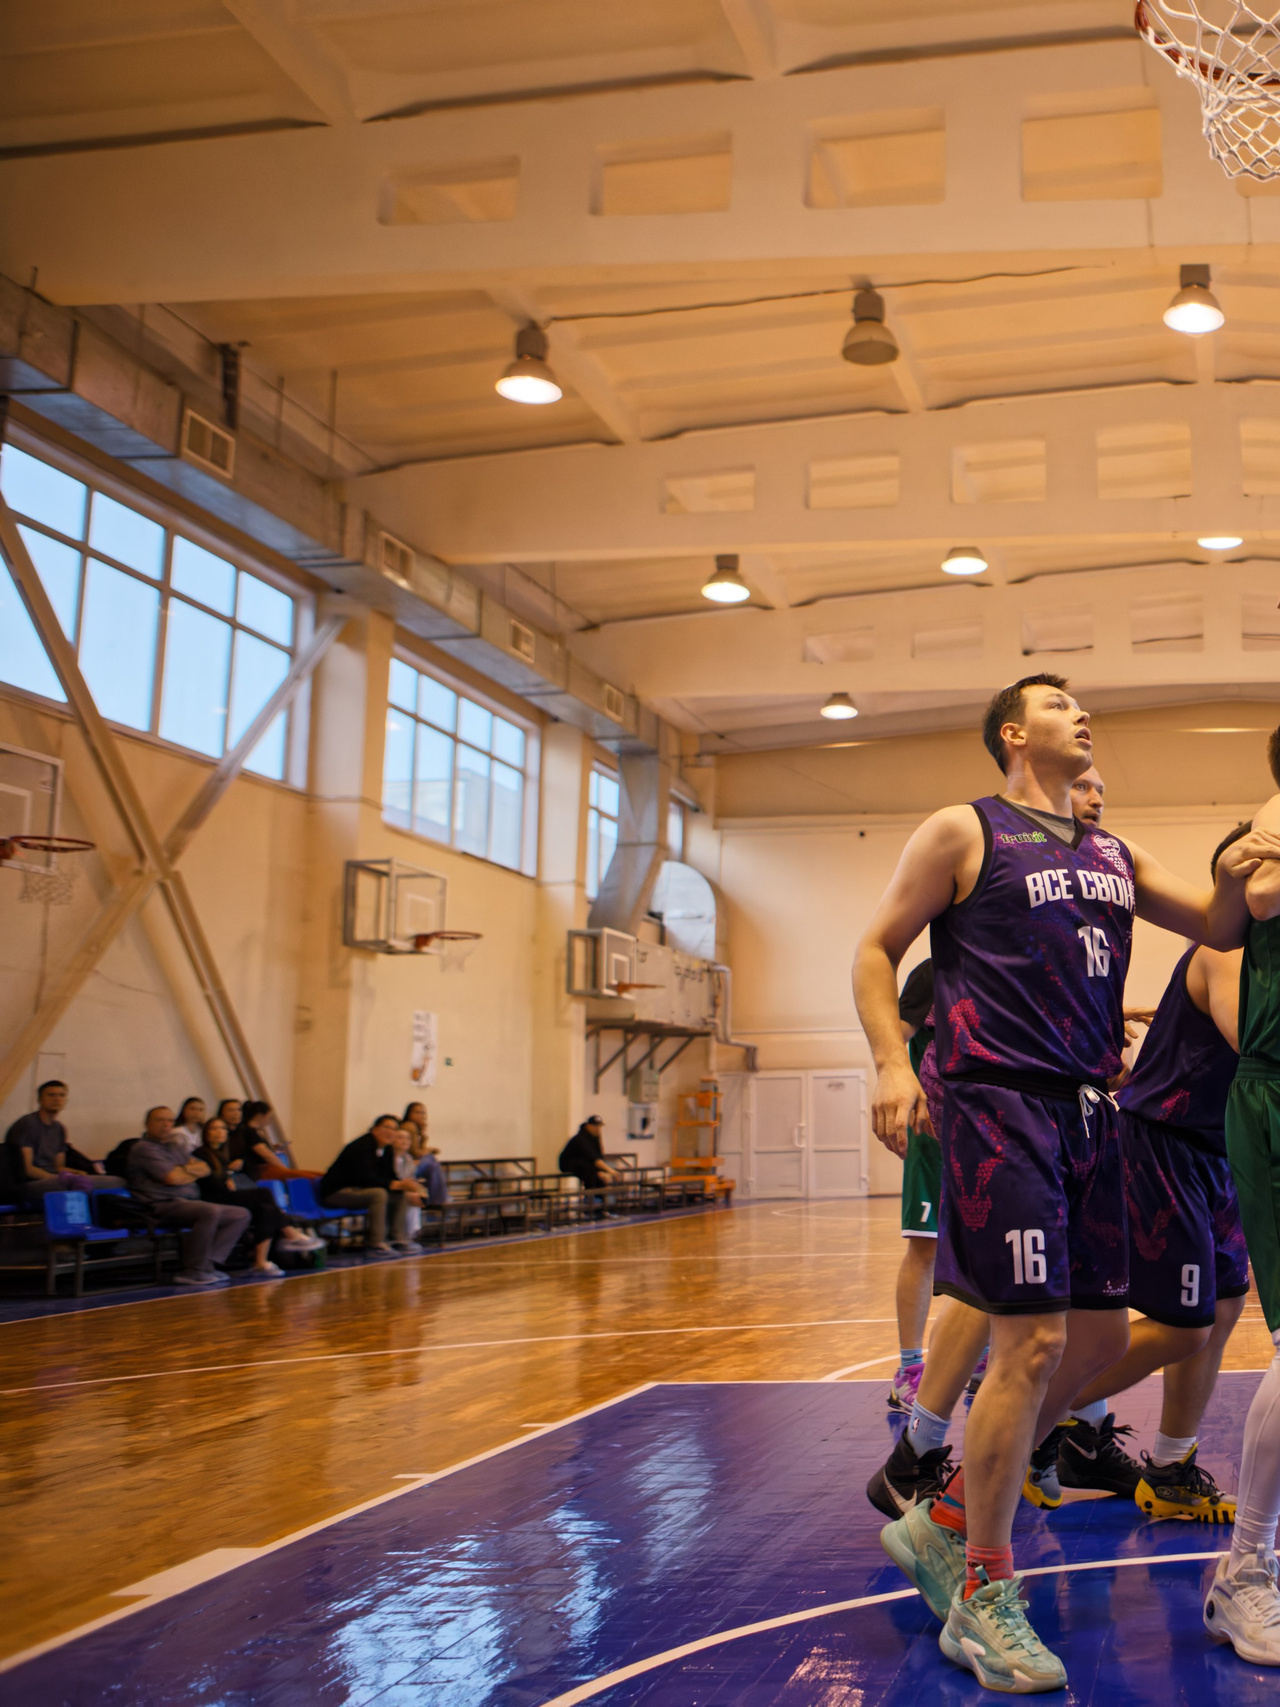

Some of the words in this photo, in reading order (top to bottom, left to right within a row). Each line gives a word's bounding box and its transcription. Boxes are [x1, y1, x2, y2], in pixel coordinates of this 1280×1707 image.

[1025, 869, 1074, 909] ВСЕ
[1077, 926, 1111, 978] 16
[920, 1201, 932, 1223] 7
[1005, 1229, 1047, 1284] 16
[1181, 1264, 1200, 1307] 9
